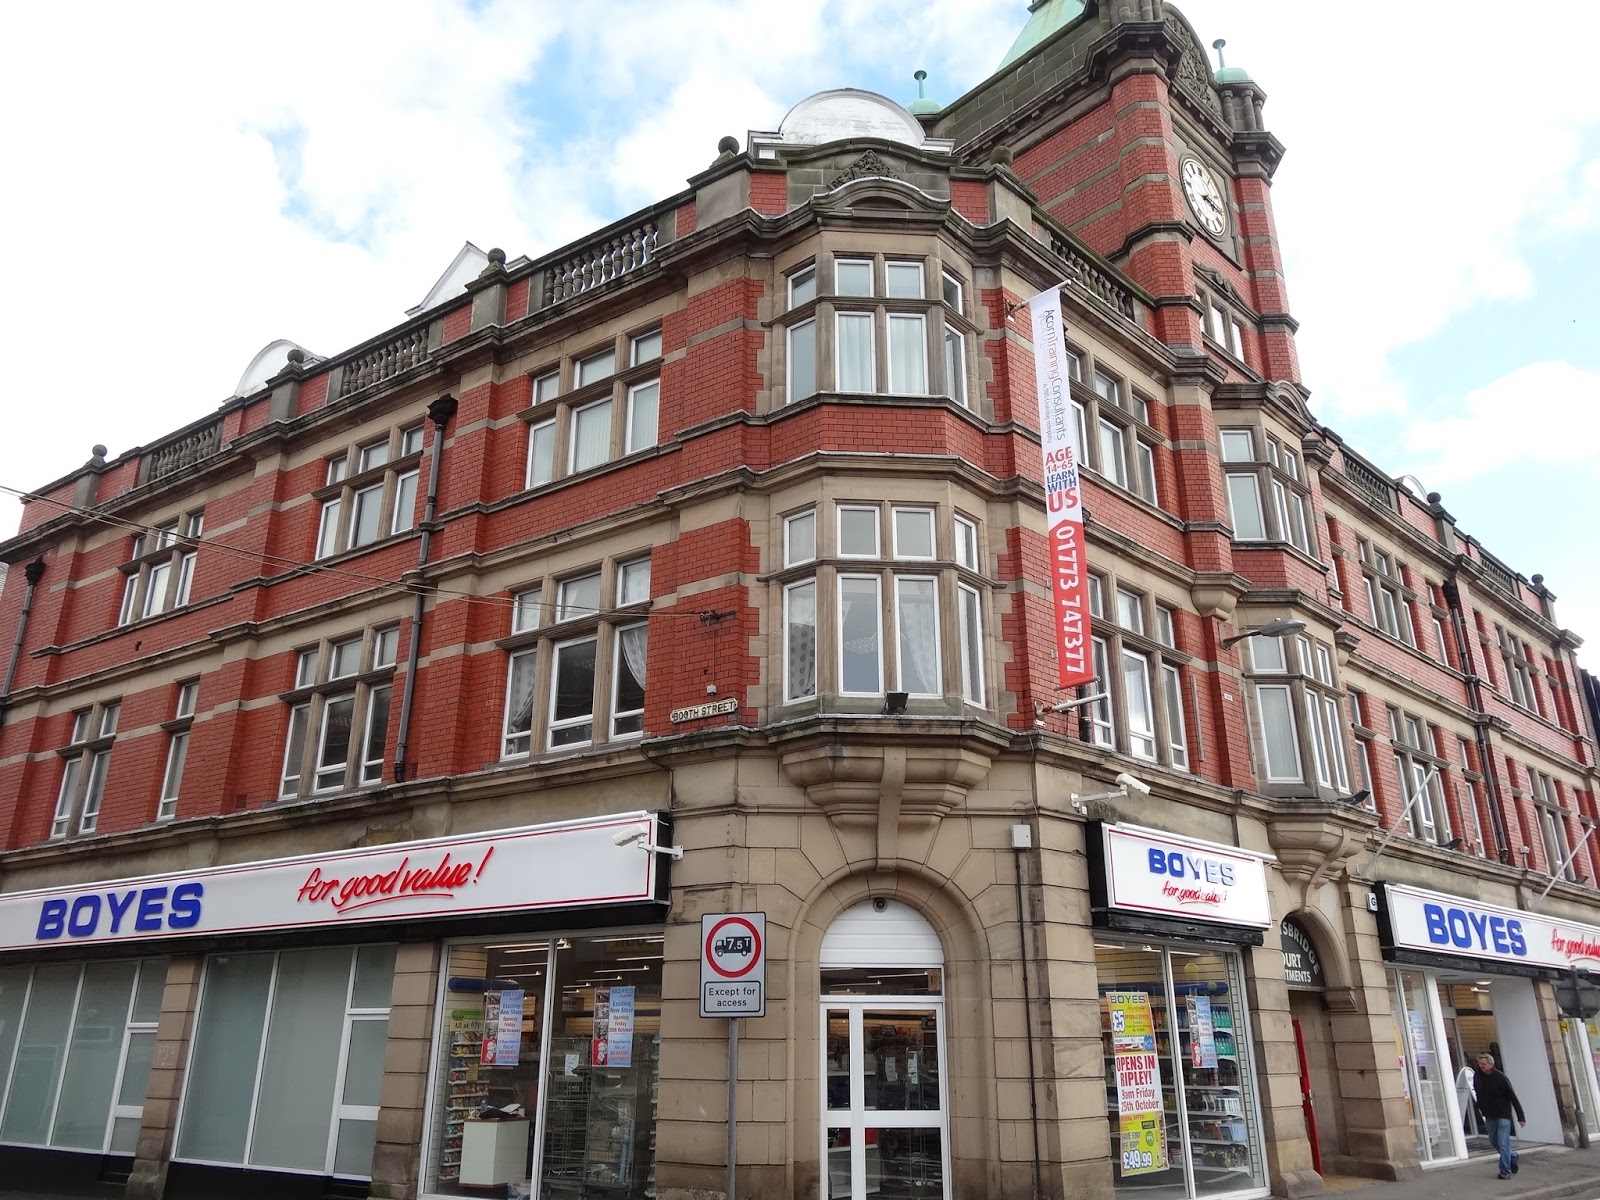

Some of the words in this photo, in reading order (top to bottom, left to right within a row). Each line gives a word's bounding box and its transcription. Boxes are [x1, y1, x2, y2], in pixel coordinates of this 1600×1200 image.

[1046, 446, 1072, 466] AGE
[1046, 459, 1073, 473] 14-65
[1047, 469, 1074, 483] LEARN
[1048, 477, 1077, 493] WITH
[1048, 487, 1078, 512] US
[1056, 526, 1080, 590] 01773
[1062, 594, 1085, 674] 747377
[673, 709, 698, 721] BOOTH
[702, 700, 735, 716] STREET
[297, 868, 339, 902] for
[332, 857, 409, 907] good
[399, 846, 494, 892] value!
[1148, 848, 1236, 886] BOYES
[1162, 881, 1179, 896] for
[1177, 887, 1201, 901] good
[36, 883, 203, 939] BOYES
[1424, 903, 1527, 956] BOYES
[1551, 928, 1565, 952] for
[1565, 934, 1584, 959] good
[708, 988, 739, 996] Except
[743, 987, 756, 995] for
[1110, 995, 1146, 1004] BOYES
[1113, 1010, 1125, 1032] £5
[1116, 1055, 1143, 1072] OPENS
[1144, 1055, 1155, 1070] IN
[1120, 1071, 1152, 1087] RIPLEY!
[1122, 1089, 1134, 1100] 9am
[1136, 1088, 1155, 1099] Friday
[1135, 1100, 1160, 1111] October
[1123, 1149, 1153, 1170] £49.99
